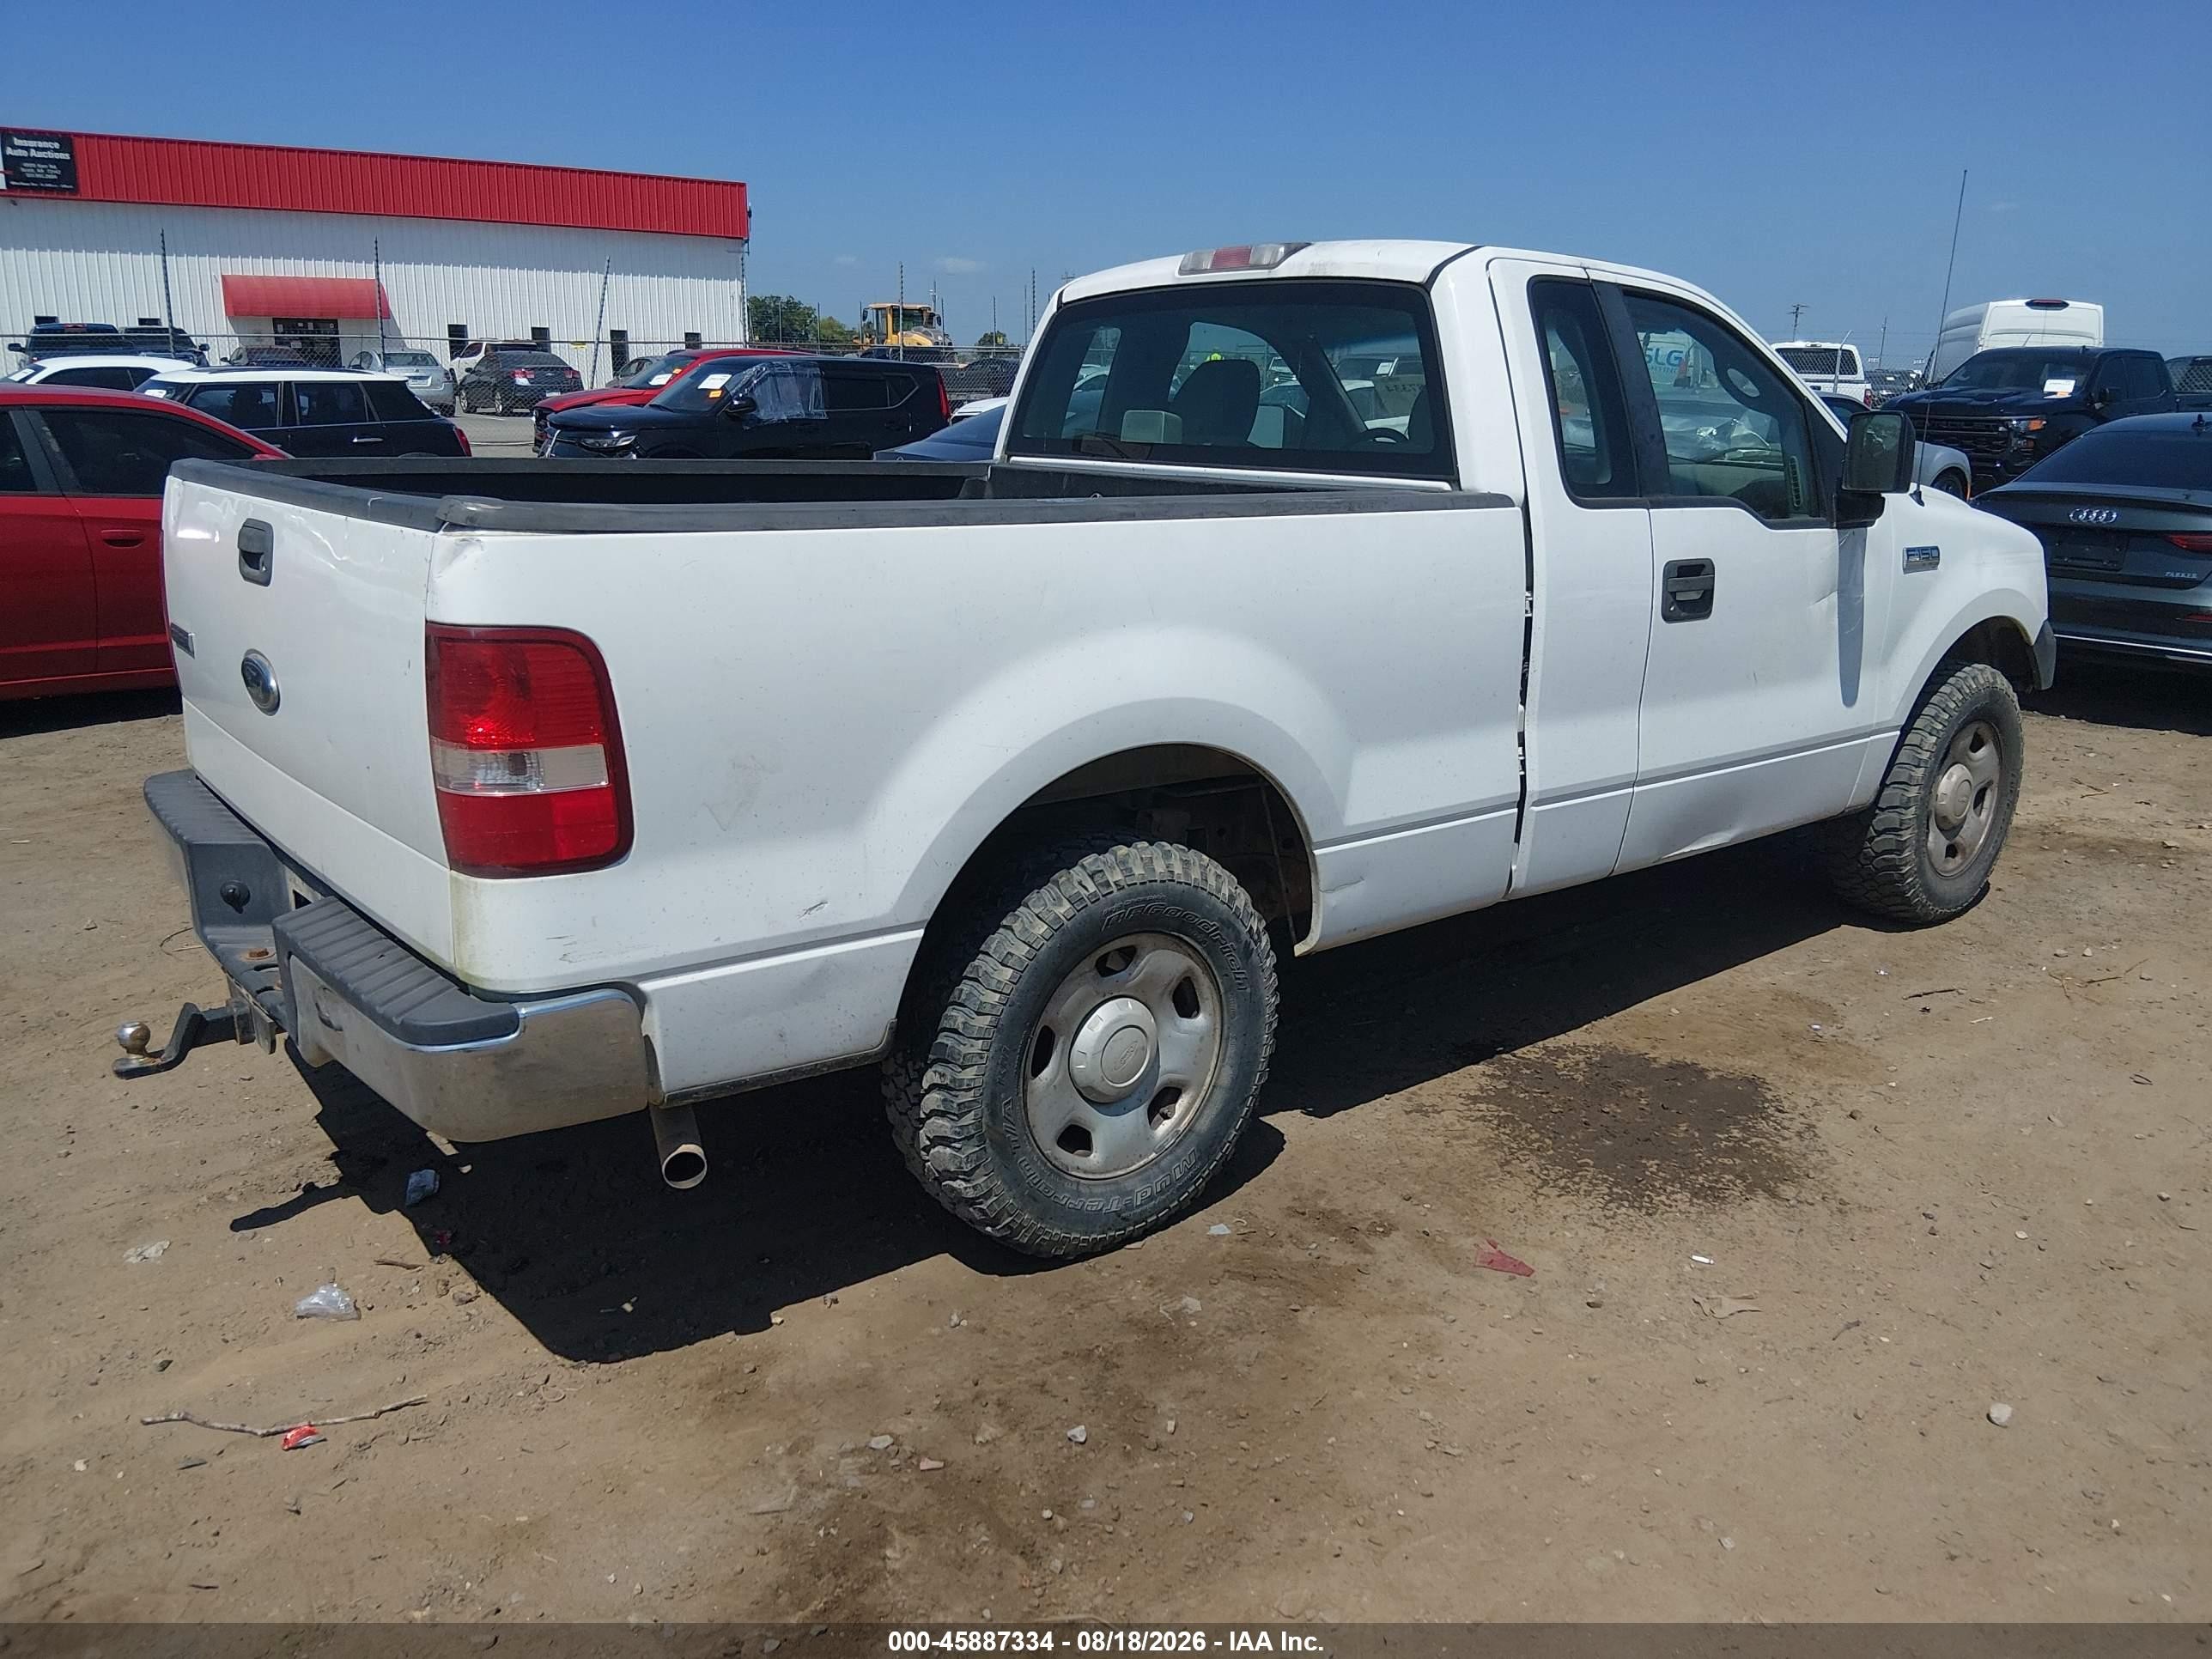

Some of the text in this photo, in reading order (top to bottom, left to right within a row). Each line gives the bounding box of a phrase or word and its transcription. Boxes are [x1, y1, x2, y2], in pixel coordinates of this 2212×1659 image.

[14, 137, 60, 149] Insurance
[6, 147, 70, 160] Auto Auctions
